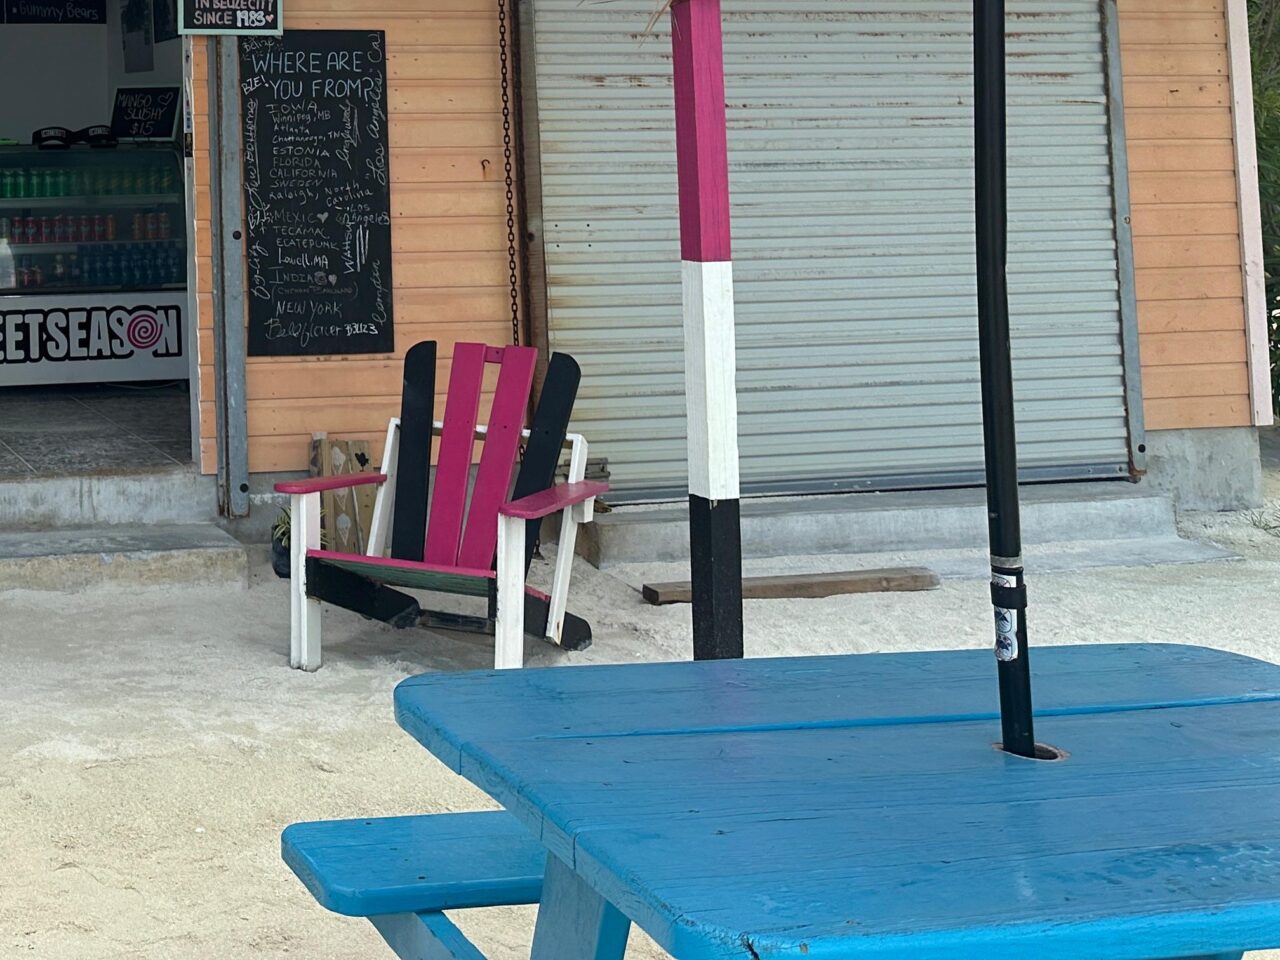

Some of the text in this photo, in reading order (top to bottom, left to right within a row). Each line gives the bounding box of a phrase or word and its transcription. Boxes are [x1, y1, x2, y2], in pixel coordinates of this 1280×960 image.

[19, 0, 100, 23] Gummy Bears
[193, 9, 267, 28] SINCE 1983
[252, 50, 363, 75] WHERE ARE
[269, 76, 375, 108] YOU FROM?
[117, 93, 153, 109] MANGO
[265, 99, 319, 115] IOWA
[124, 106, 168, 121] SLUSHY
[129, 120, 156, 136] $15
[273, 123, 311, 135] Atlanta
[272, 146, 331, 158] ESTONIA
[272, 156, 322, 169] FLORIDA
[269, 168, 339, 179] CALIFORNIA
[270, 179, 324, 189] SWEDEN
[267, 266, 314, 285] INDIA
[276, 300, 343, 321] NEW YORK
